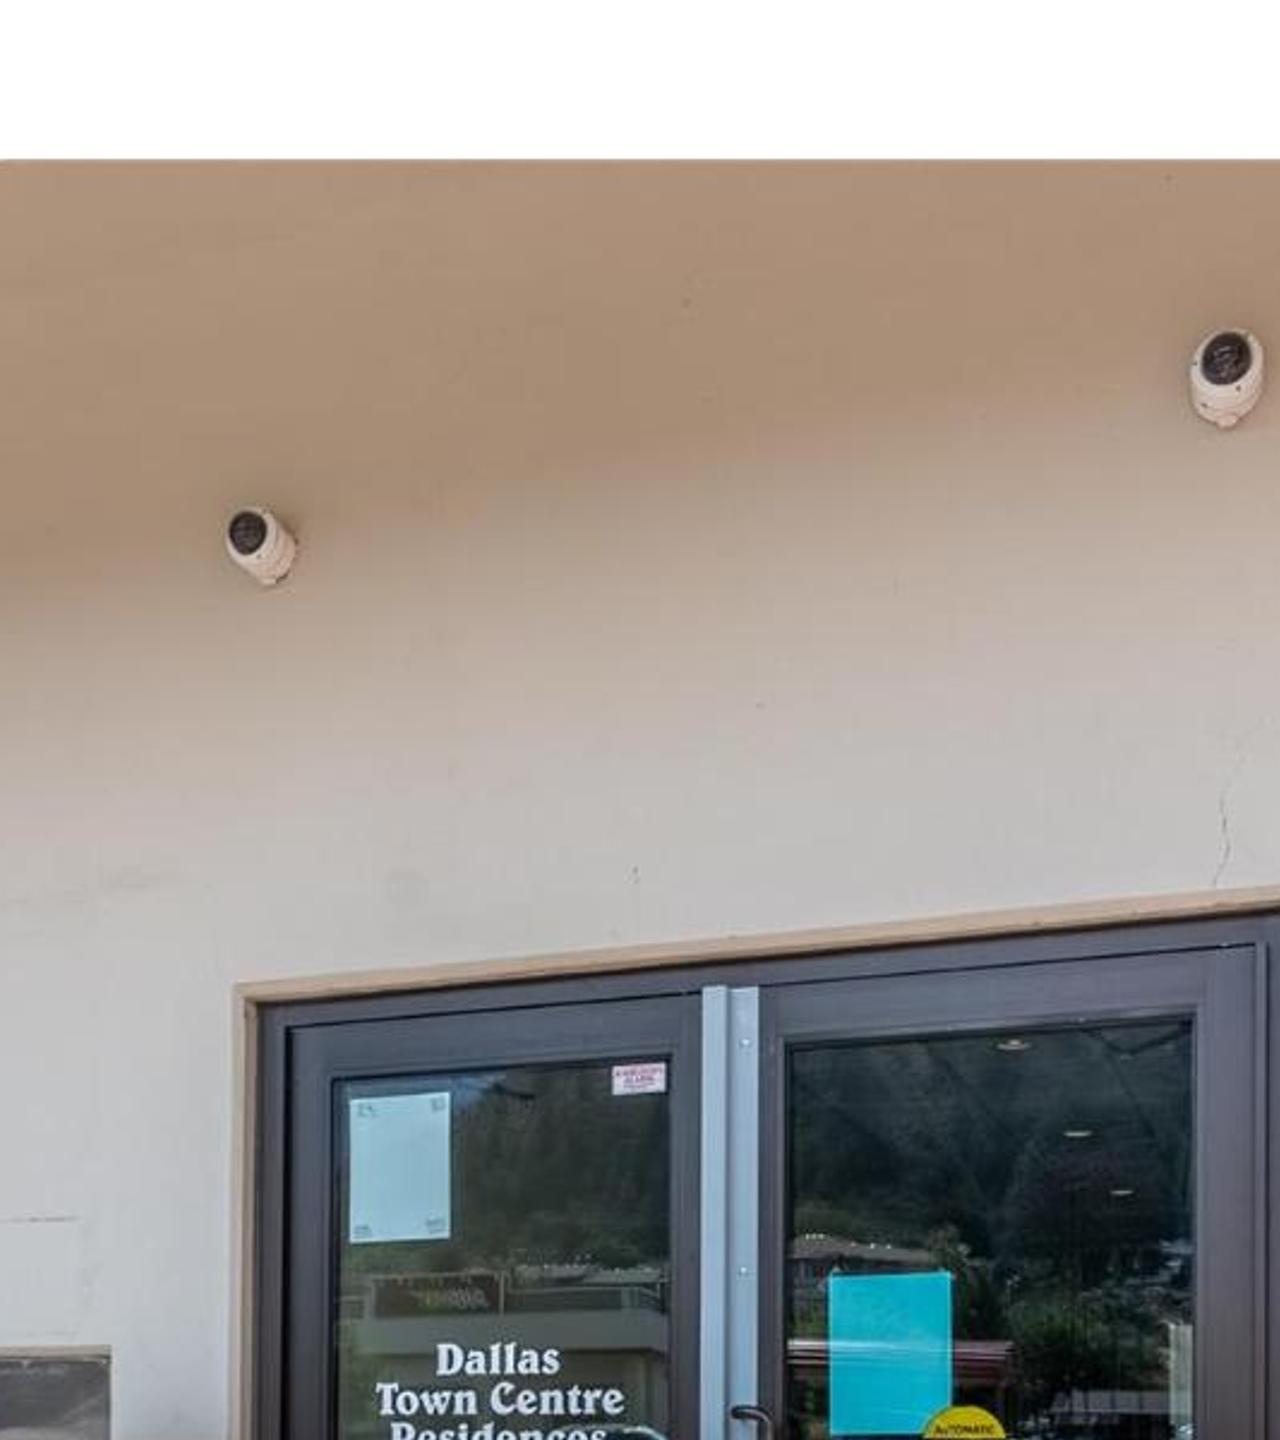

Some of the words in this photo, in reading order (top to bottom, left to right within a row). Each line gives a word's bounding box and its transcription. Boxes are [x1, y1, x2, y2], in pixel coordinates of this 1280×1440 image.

[436, 1342, 561, 1376] Dallas
[375, 1382, 478, 1416] Town
[490, 1381, 625, 1416] Centre
